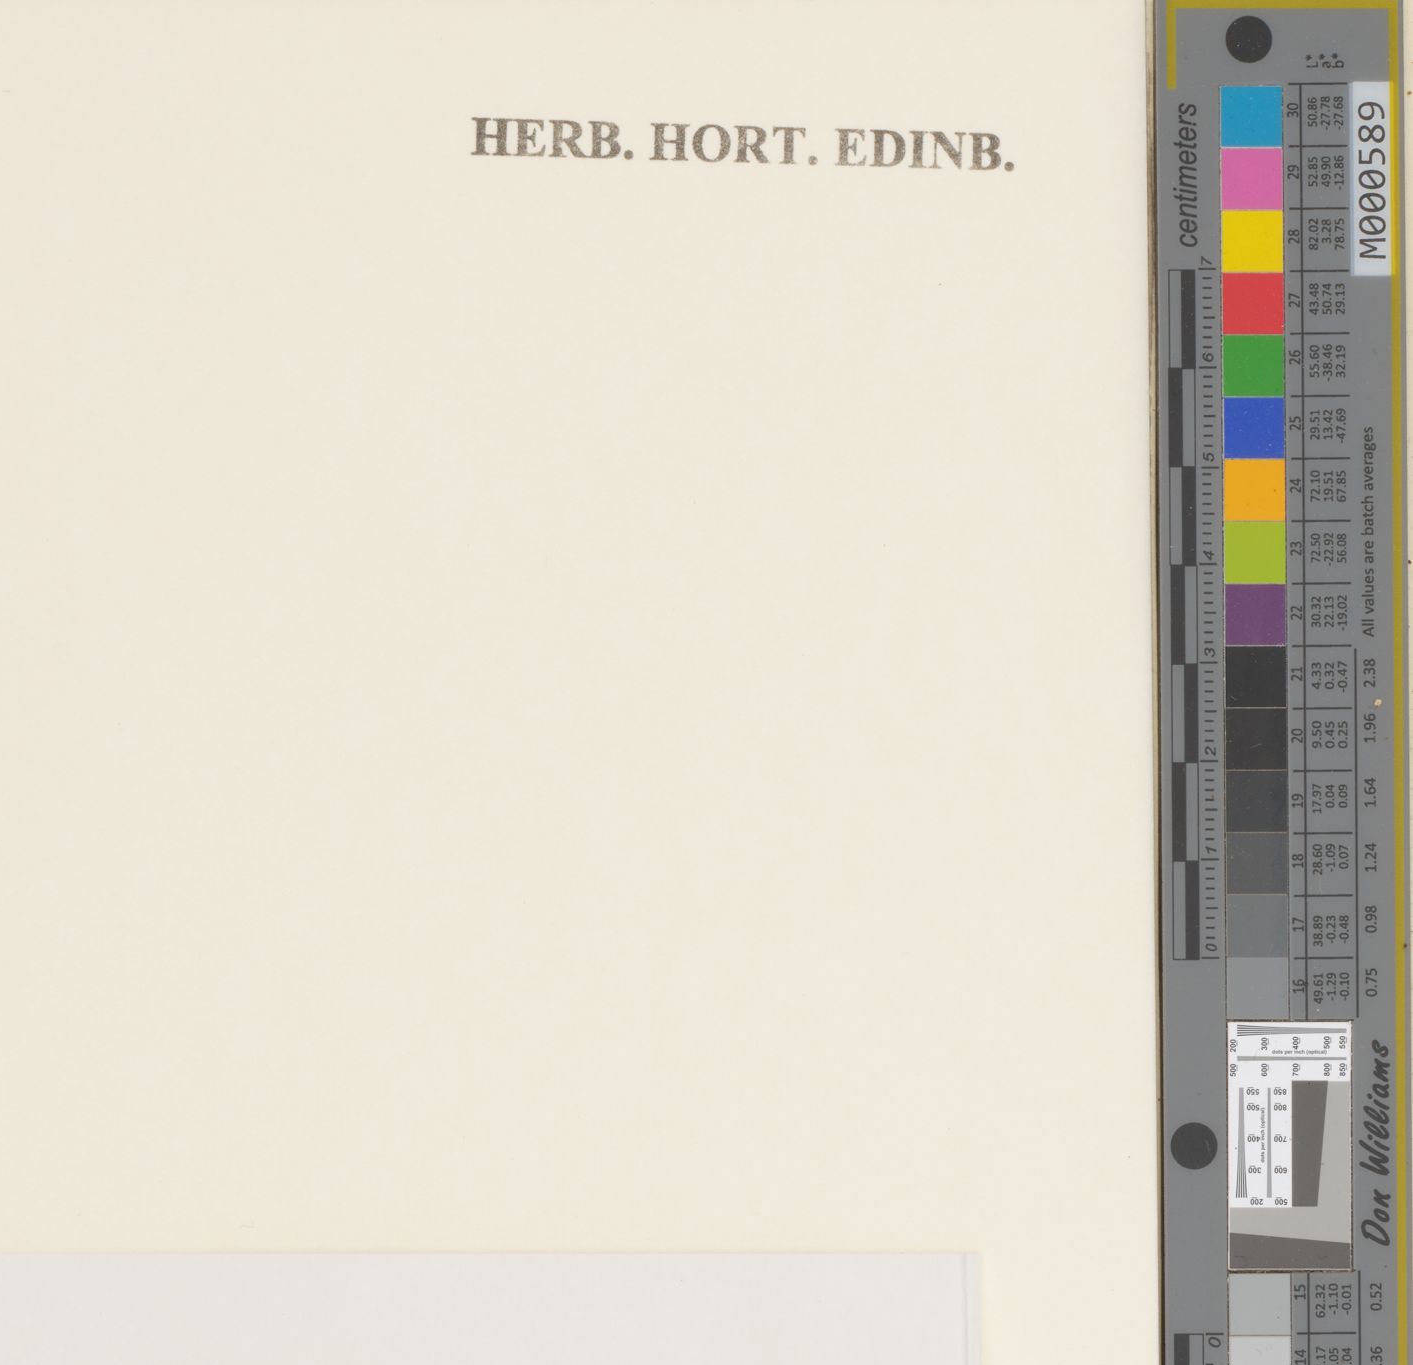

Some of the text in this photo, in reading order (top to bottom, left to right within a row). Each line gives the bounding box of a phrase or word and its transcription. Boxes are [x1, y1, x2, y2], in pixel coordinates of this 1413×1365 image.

[470, 116, 1015, 172] HERB. HORT. EDINB.
[1172, 102, 1199, 248] centimeters
[1357, 101, 1387, 260] M000589
[1286, 102, 1305, 558] 23 24 25 26 27 28 29 30
[1306, 96, 1322, 564] 72.50 72.10 29.51 55.60 43.48 82.02 52.85 50.86
[1200, 255, 1217, 757] 2 3 4 5 6 7
[1360, 426, 1377, 638] All values are batch averages
[1362, 658, 1378, 998] 0.75 0.98 1.24 1.64 1.96 2.38
[1358, 1039, 1391, 1247] Don Williams
[1369, 1282, 1383, 1312] 0.52
